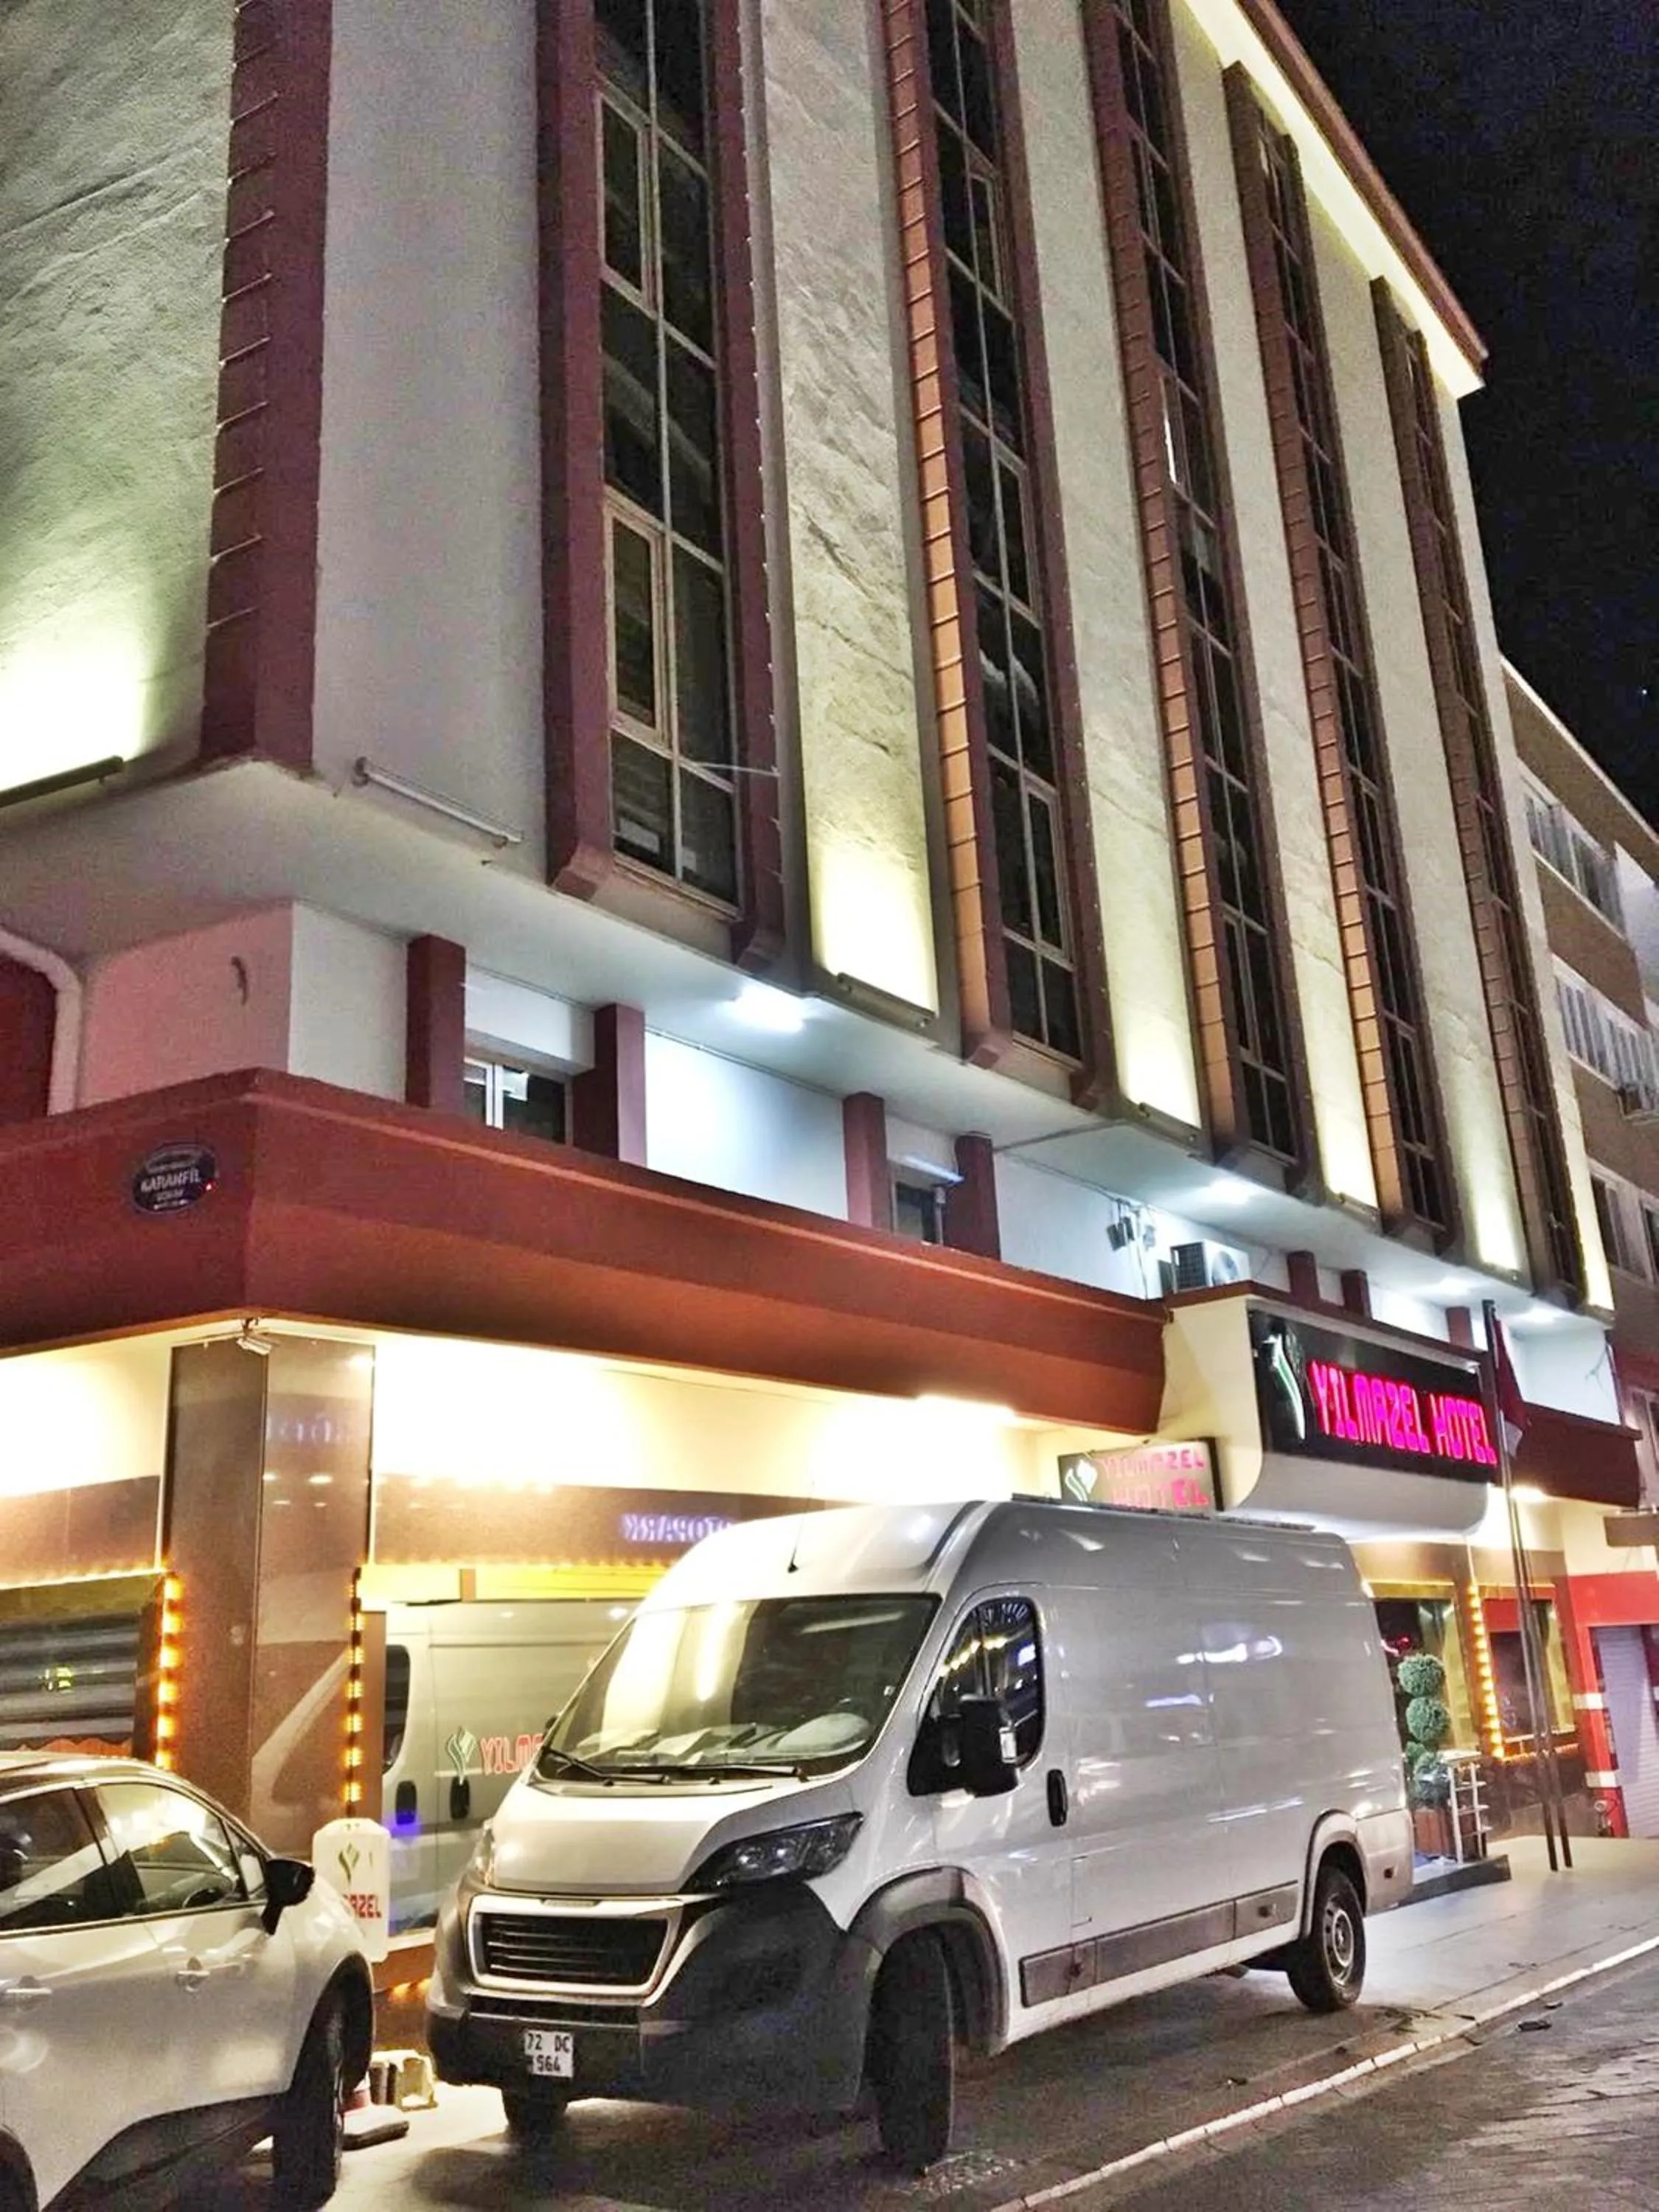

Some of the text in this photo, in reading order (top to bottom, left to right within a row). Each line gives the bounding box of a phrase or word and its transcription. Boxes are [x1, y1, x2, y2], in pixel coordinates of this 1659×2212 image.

[1429, 1392, 1498, 1466] HOTEL
[554, 2034, 570, 2053] DC
[536, 2053, 561, 2073] 564
